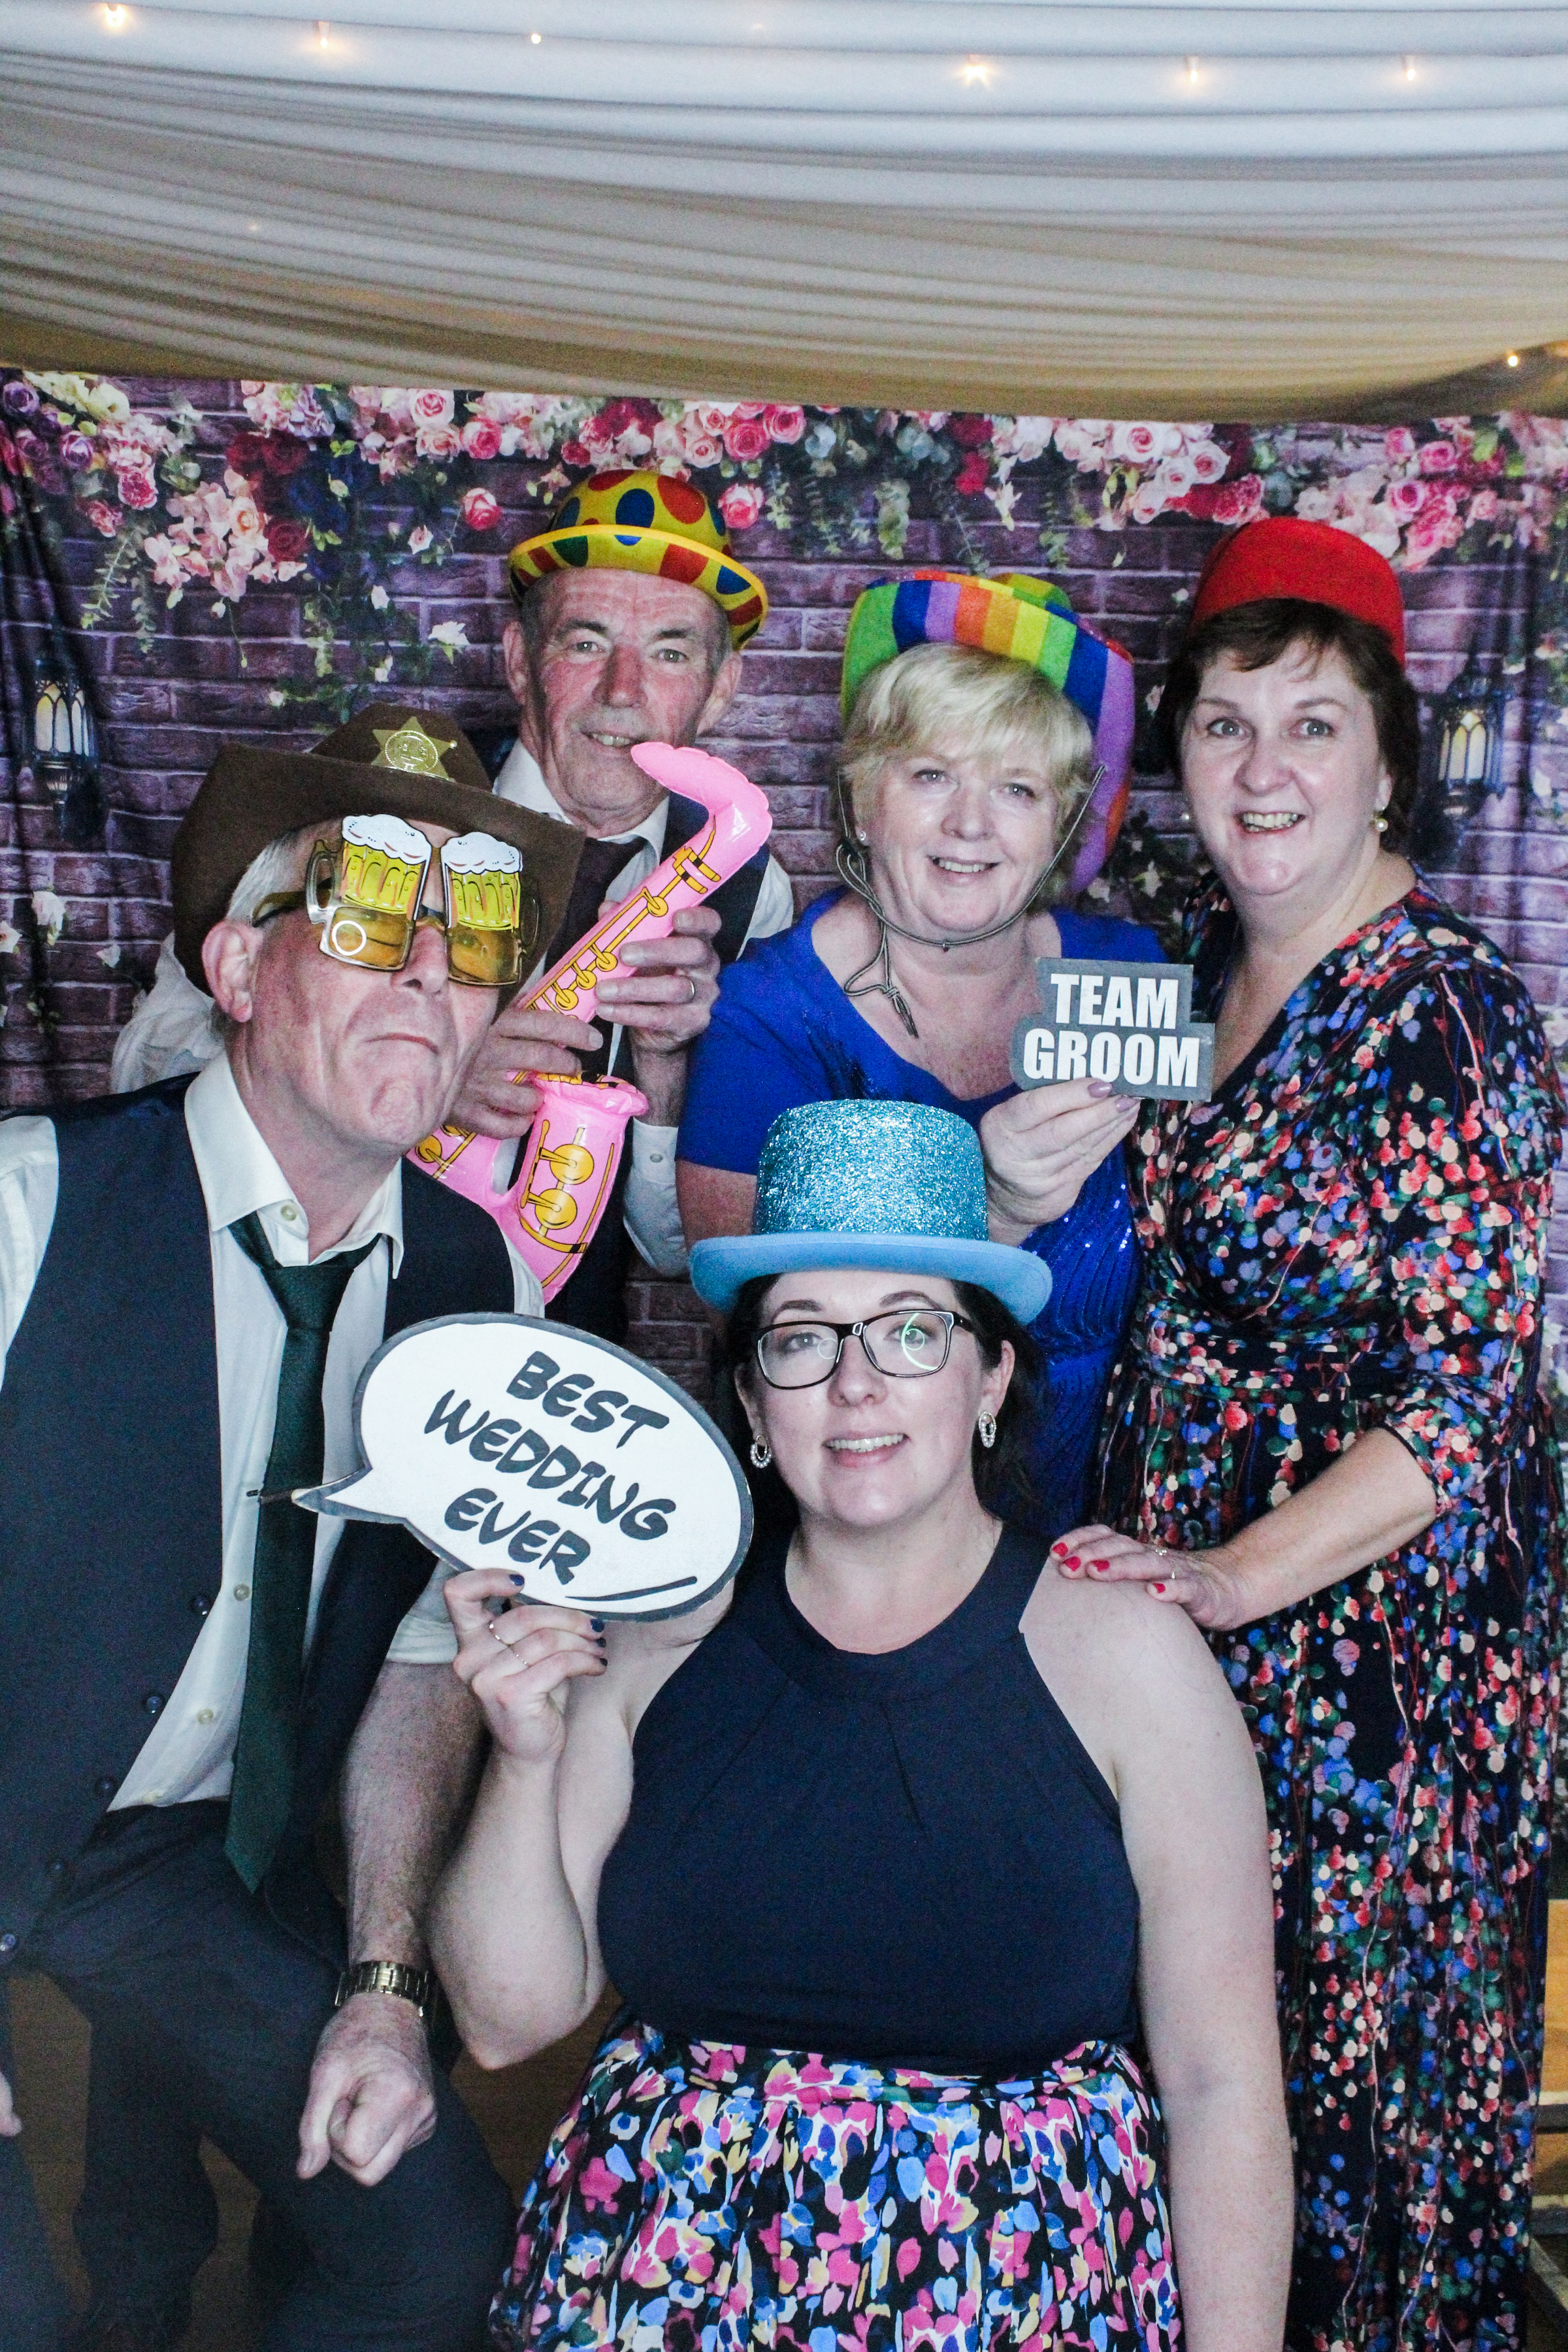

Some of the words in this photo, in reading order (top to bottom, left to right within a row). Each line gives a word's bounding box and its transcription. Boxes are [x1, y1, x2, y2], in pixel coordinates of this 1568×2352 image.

[1051, 973, 1179, 1030] TEAM
[1023, 1028, 1200, 1087] GROOM
[506, 1351, 670, 1448] BEST
[424, 1390, 676, 1540] WEDDING
[444, 1488, 591, 1585] EVER
